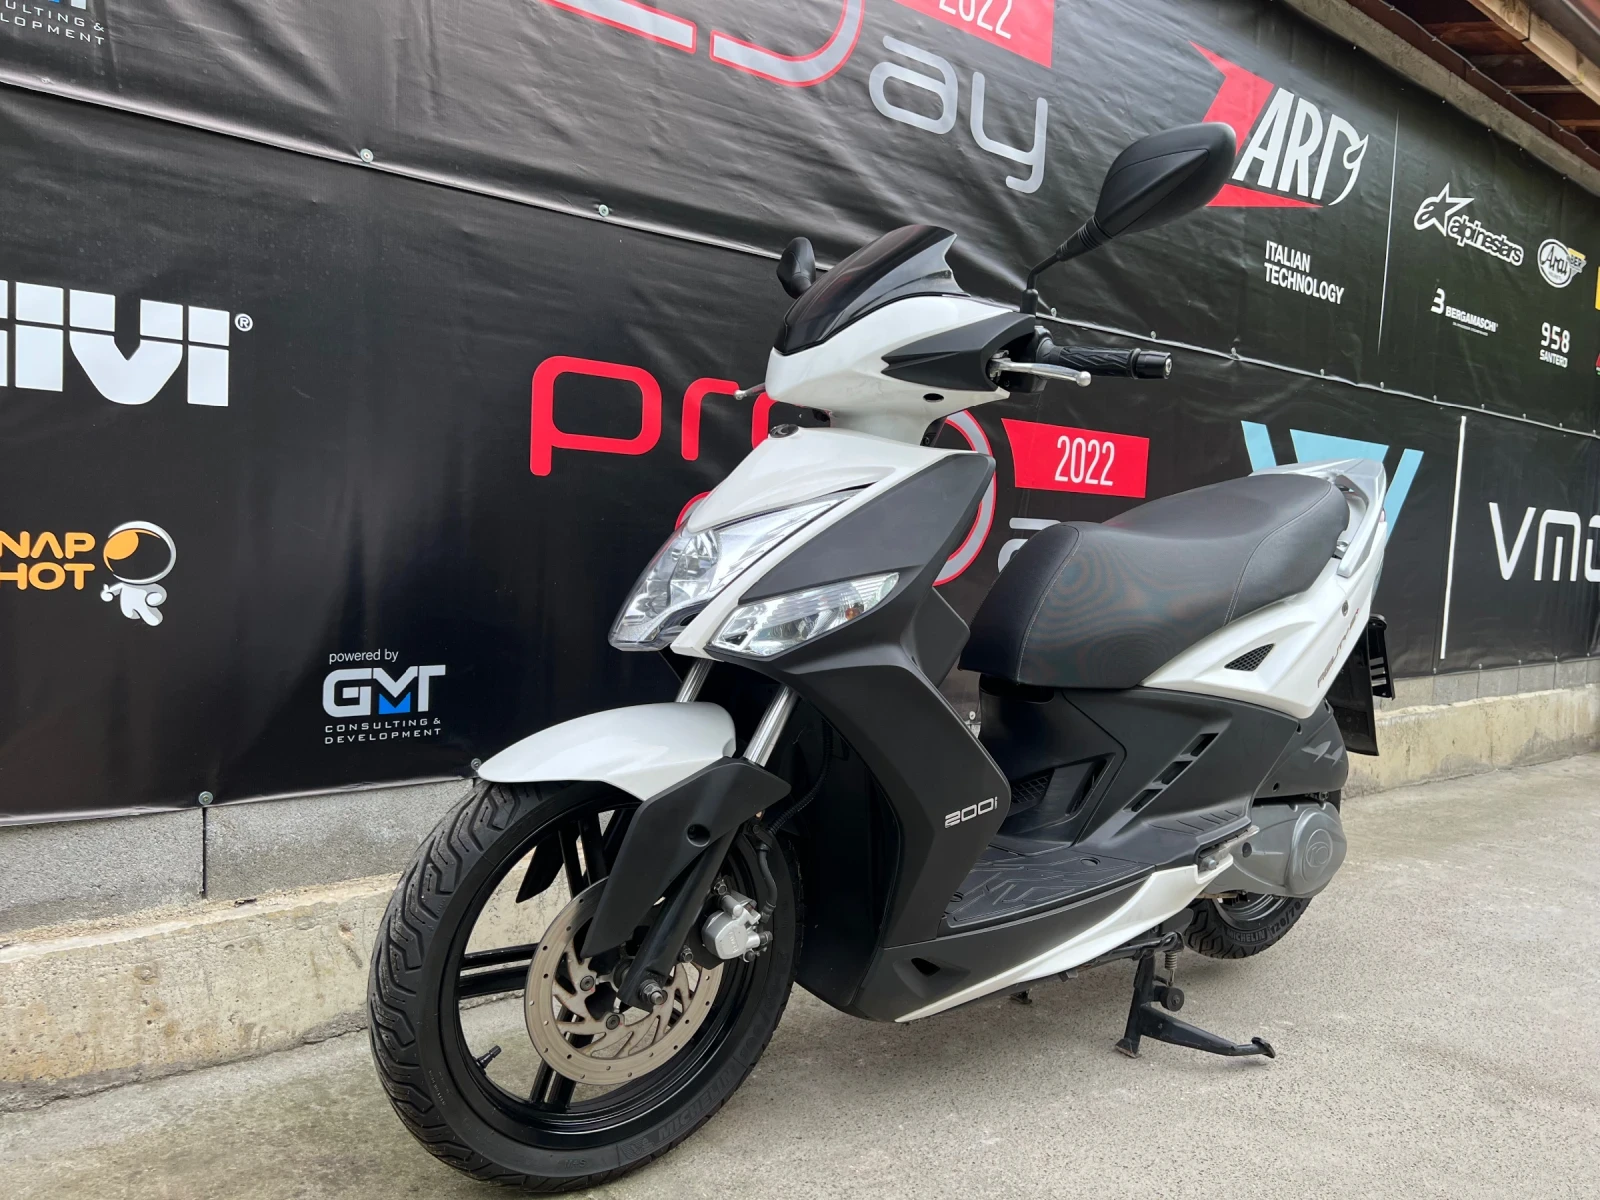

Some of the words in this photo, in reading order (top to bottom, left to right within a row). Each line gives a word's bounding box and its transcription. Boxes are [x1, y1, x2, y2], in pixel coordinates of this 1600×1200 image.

[0, 12, 105, 46] LOPMENT
[93, 22, 105, 33] &
[1265, 240, 1311, 273] ITALIAN
[1263, 262, 1345, 305] TECHNOLOGY
[1445, 305, 1497, 333] BERGAMASCHI
[1539, 349, 1568, 369] SANTERO
[1054, 434, 1116, 488] 2022
[328, 648, 381, 665] powered
[384, 648, 399, 662] by
[322, 664, 446, 718] GMT
[324, 728, 442, 745] DEVELOPMENT
[325, 718, 428, 733] CONSULTING
[432, 717, 441, 725] &
[944, 796, 998, 829] 200i
[1226, 928, 1267, 943] MICHELIN
[656, 1063, 739, 1143] MICHELIN
